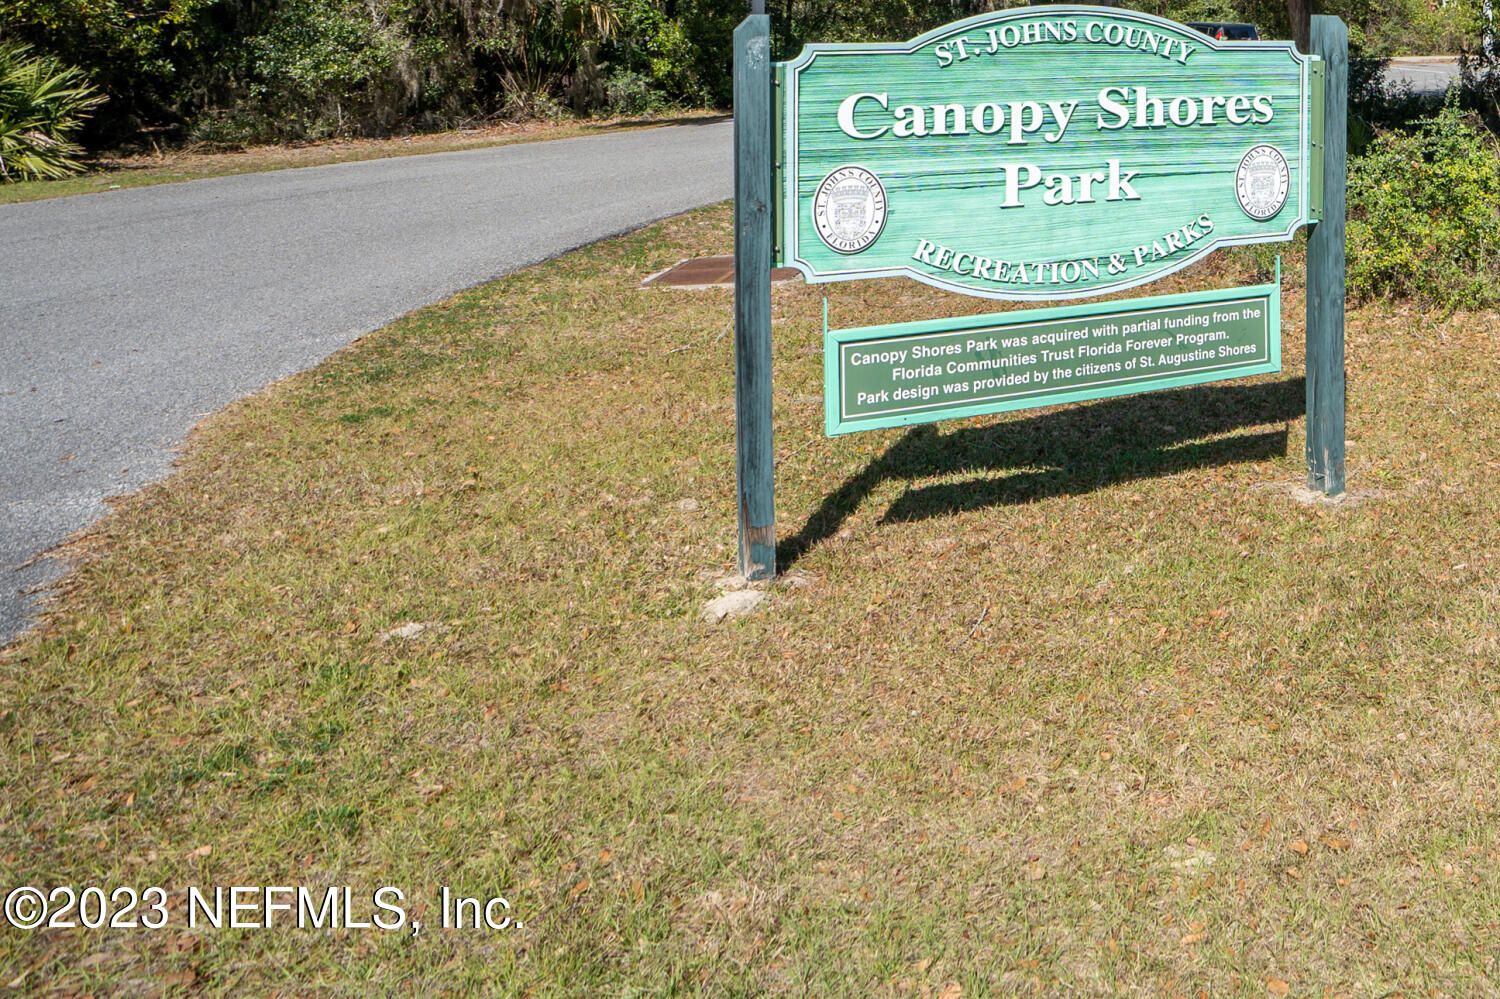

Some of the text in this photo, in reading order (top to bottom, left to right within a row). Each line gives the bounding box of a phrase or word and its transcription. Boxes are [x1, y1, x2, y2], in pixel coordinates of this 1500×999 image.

[935, 20, 1196, 68] ST. JOHNS COUNTY
[837, 86, 1275, 145] Canopy Shores
[1000, 159, 1141, 209] Park
[911, 212, 1215, 284] RECREATION & PARKS
[850, 308, 1261, 366] Canopy Shores Park was acquired with partial funding from the
[892, 331, 1230, 381] Florida Communities Trust Florida Forever Program.
[857, 343, 1257, 405] Park design was provided by the citizens of St. Augustine Shores
